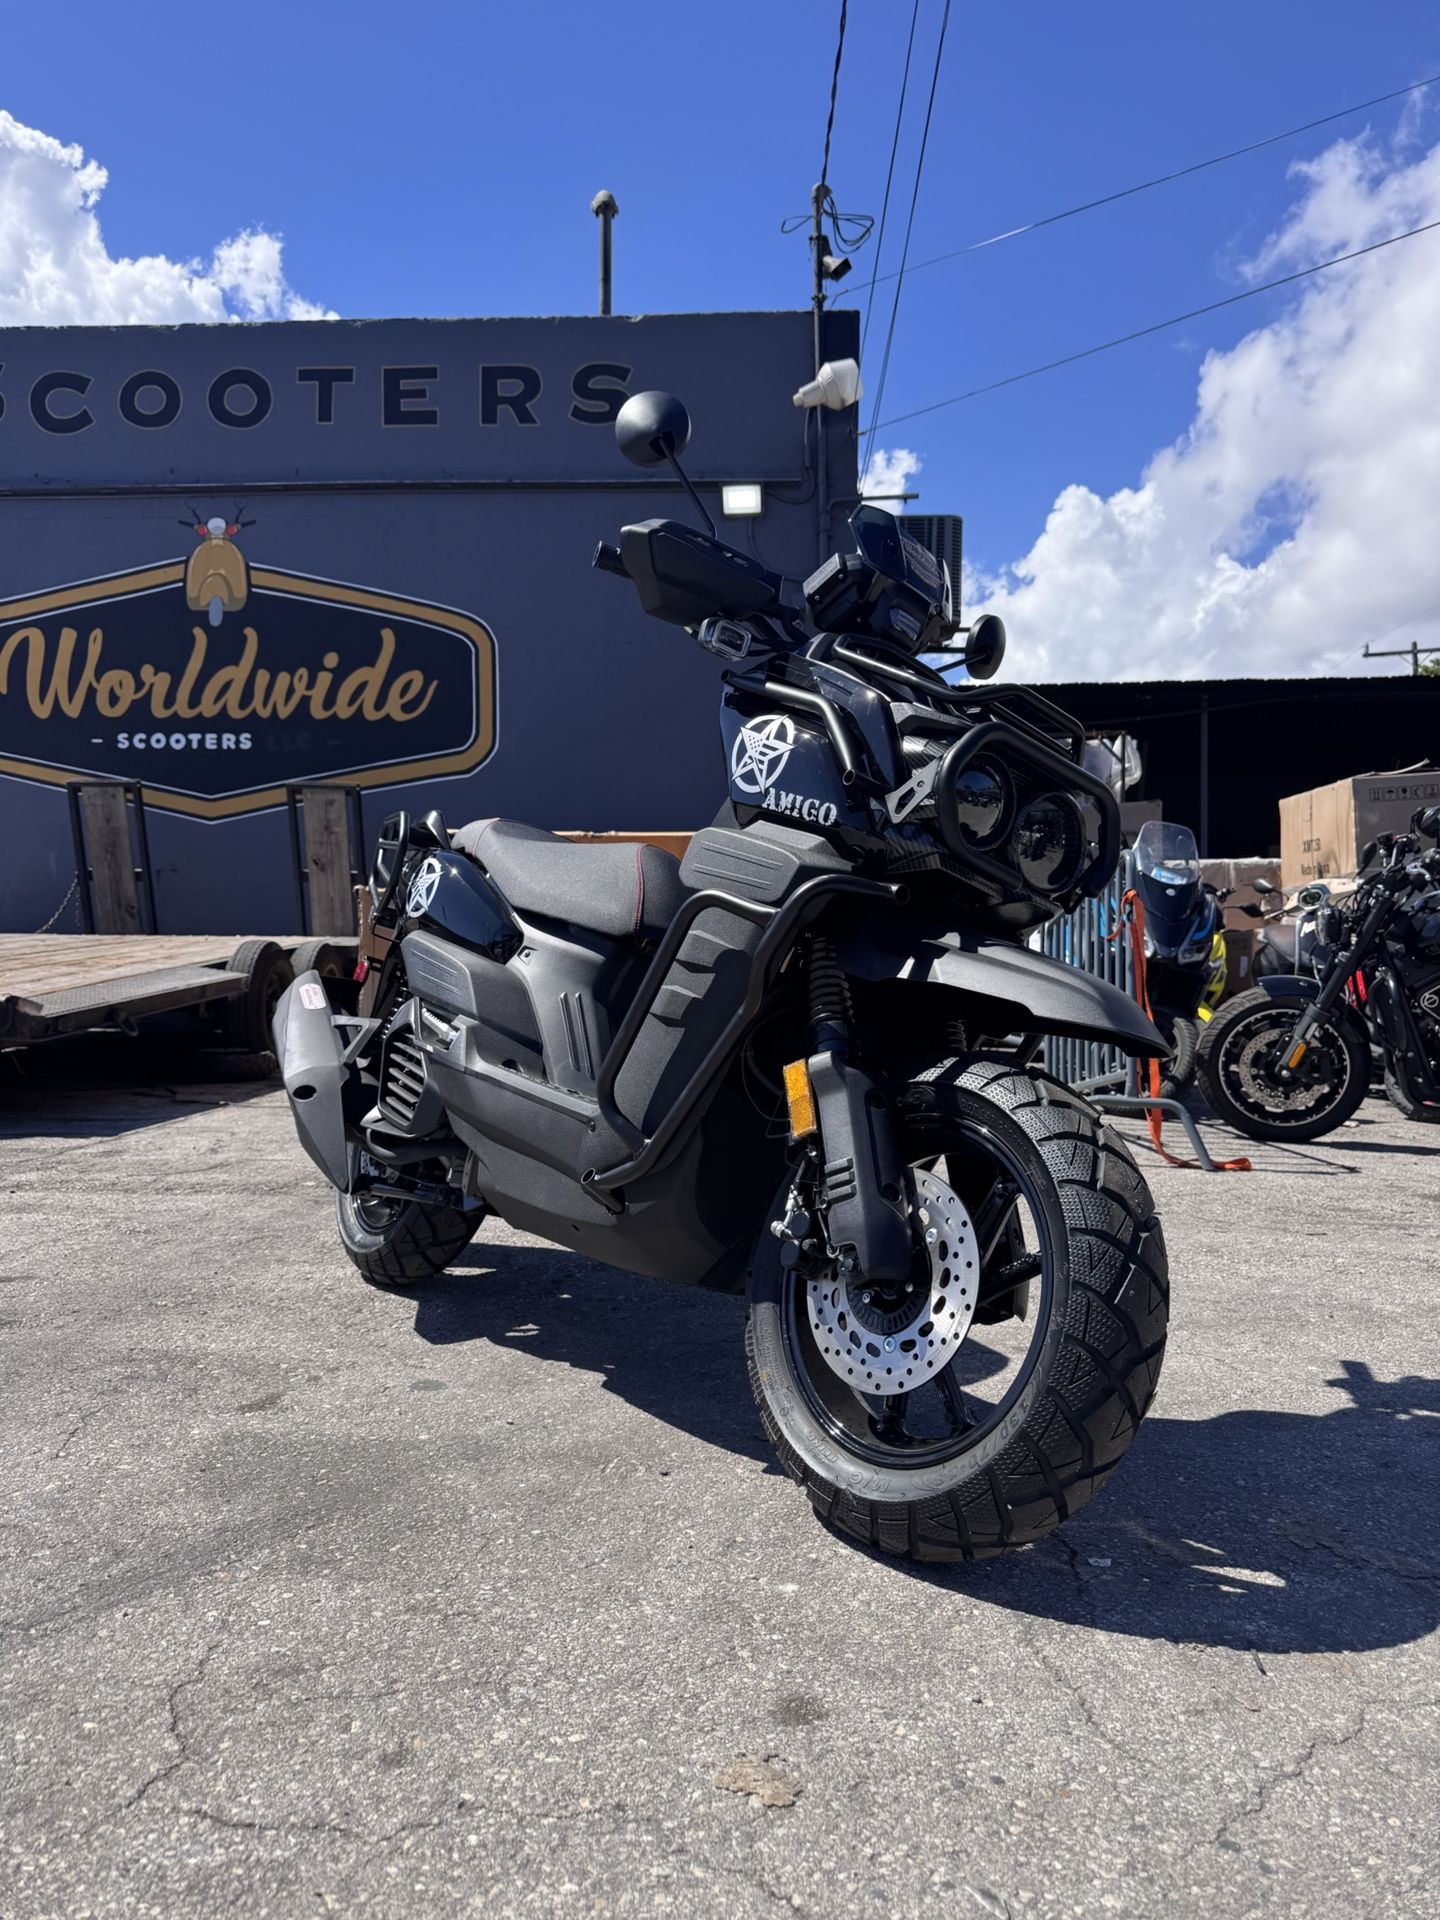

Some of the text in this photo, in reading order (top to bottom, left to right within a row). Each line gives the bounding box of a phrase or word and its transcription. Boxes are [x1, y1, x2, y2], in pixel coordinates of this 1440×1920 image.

[0, 362, 633, 435] COOTERS
[0, 626, 438, 722] Worldwide
[117, 732, 252, 750] SCOOTERS
[761, 787, 837, 826] AMIGO
